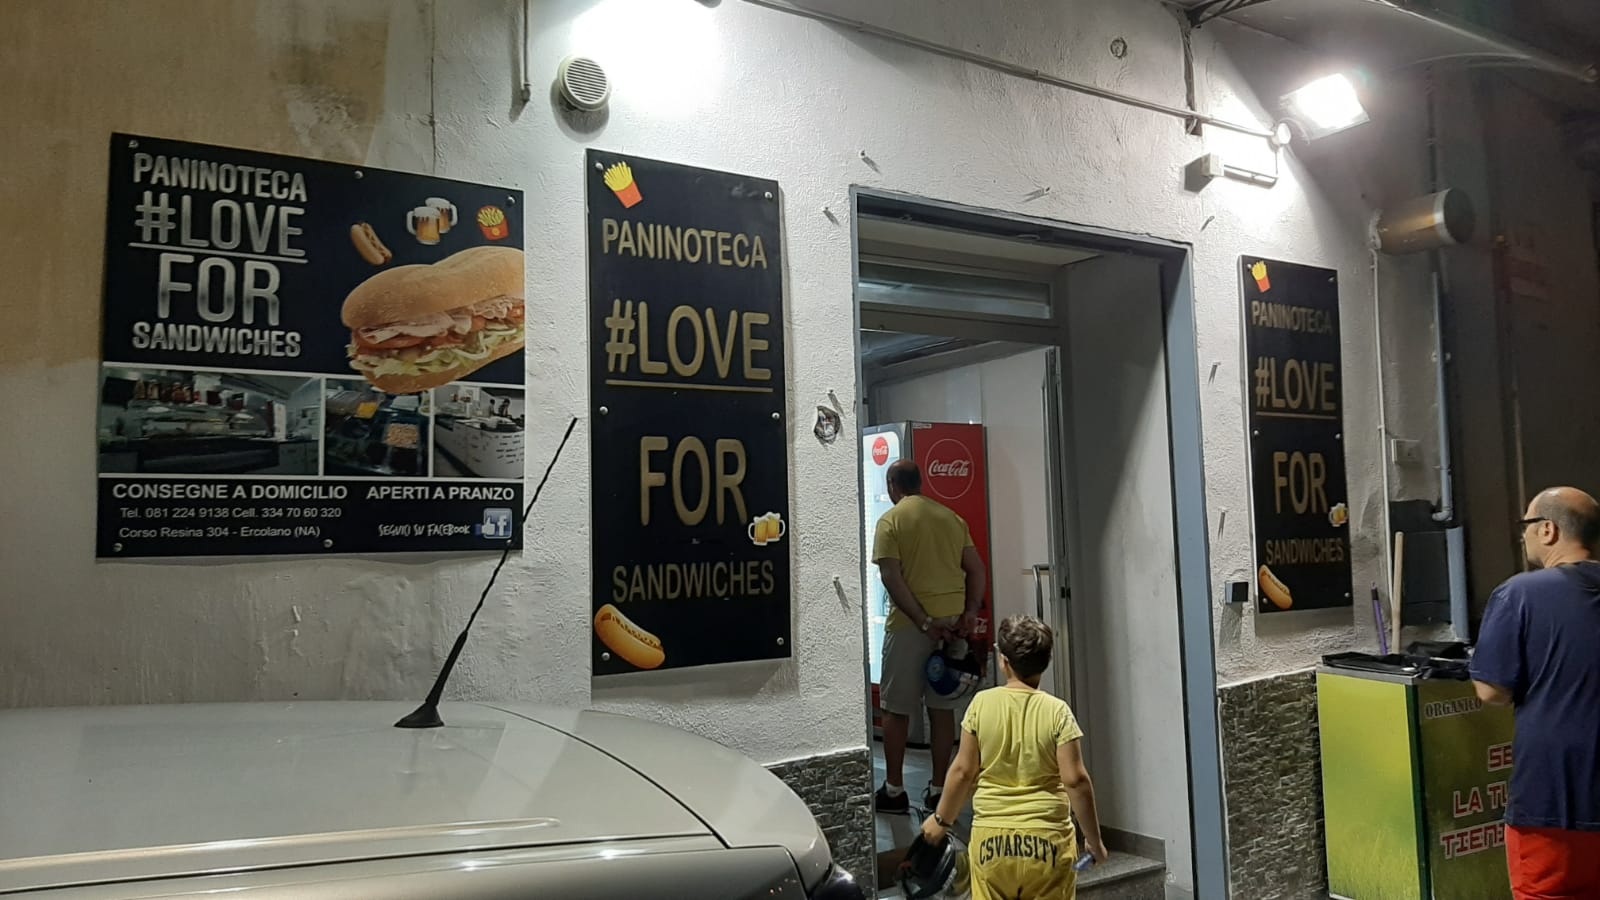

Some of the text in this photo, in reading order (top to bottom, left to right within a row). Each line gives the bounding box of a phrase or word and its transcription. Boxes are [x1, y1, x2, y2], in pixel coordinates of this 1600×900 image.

[133, 153, 307, 202] PANINOTECA
[136, 190, 306, 257] #LOVE
[602, 218, 768, 269] PANINOTECA
[157, 252, 281, 327] FOR
[1252, 300, 1333, 334] PANINOTECA
[131, 321, 301, 358] SANDWICHES
[605, 299, 772, 380] #LOVE
[1255, 356, 1336, 411] #LOVE
[112, 483, 348, 500] CONSEGNE A DOMICILIO
[366, 486, 515, 500] APERTI A PRANZO
[639, 435, 748, 526] FOR
[1272, 451, 1328, 514] FOR
[120, 507, 342, 518] Tel. 081 224 9138 Cell. 334 70 60 320
[119, 527, 157, 538] Corso
[160, 527, 203, 538] Resina
[206, 527, 229, 537] 304
[240, 526, 291, 537] Ercolano
[294, 526, 320, 538] (NA)
[413, 524, 426, 537] SU
[1265, 538, 1345, 566] SANDWICHES
[612, 560, 775, 603] SANDWICHES
[1425, 696, 1483, 719] ORGANICO
[1454, 787, 1484, 818] LA
[980, 834, 1057, 868] CSVARSITY
